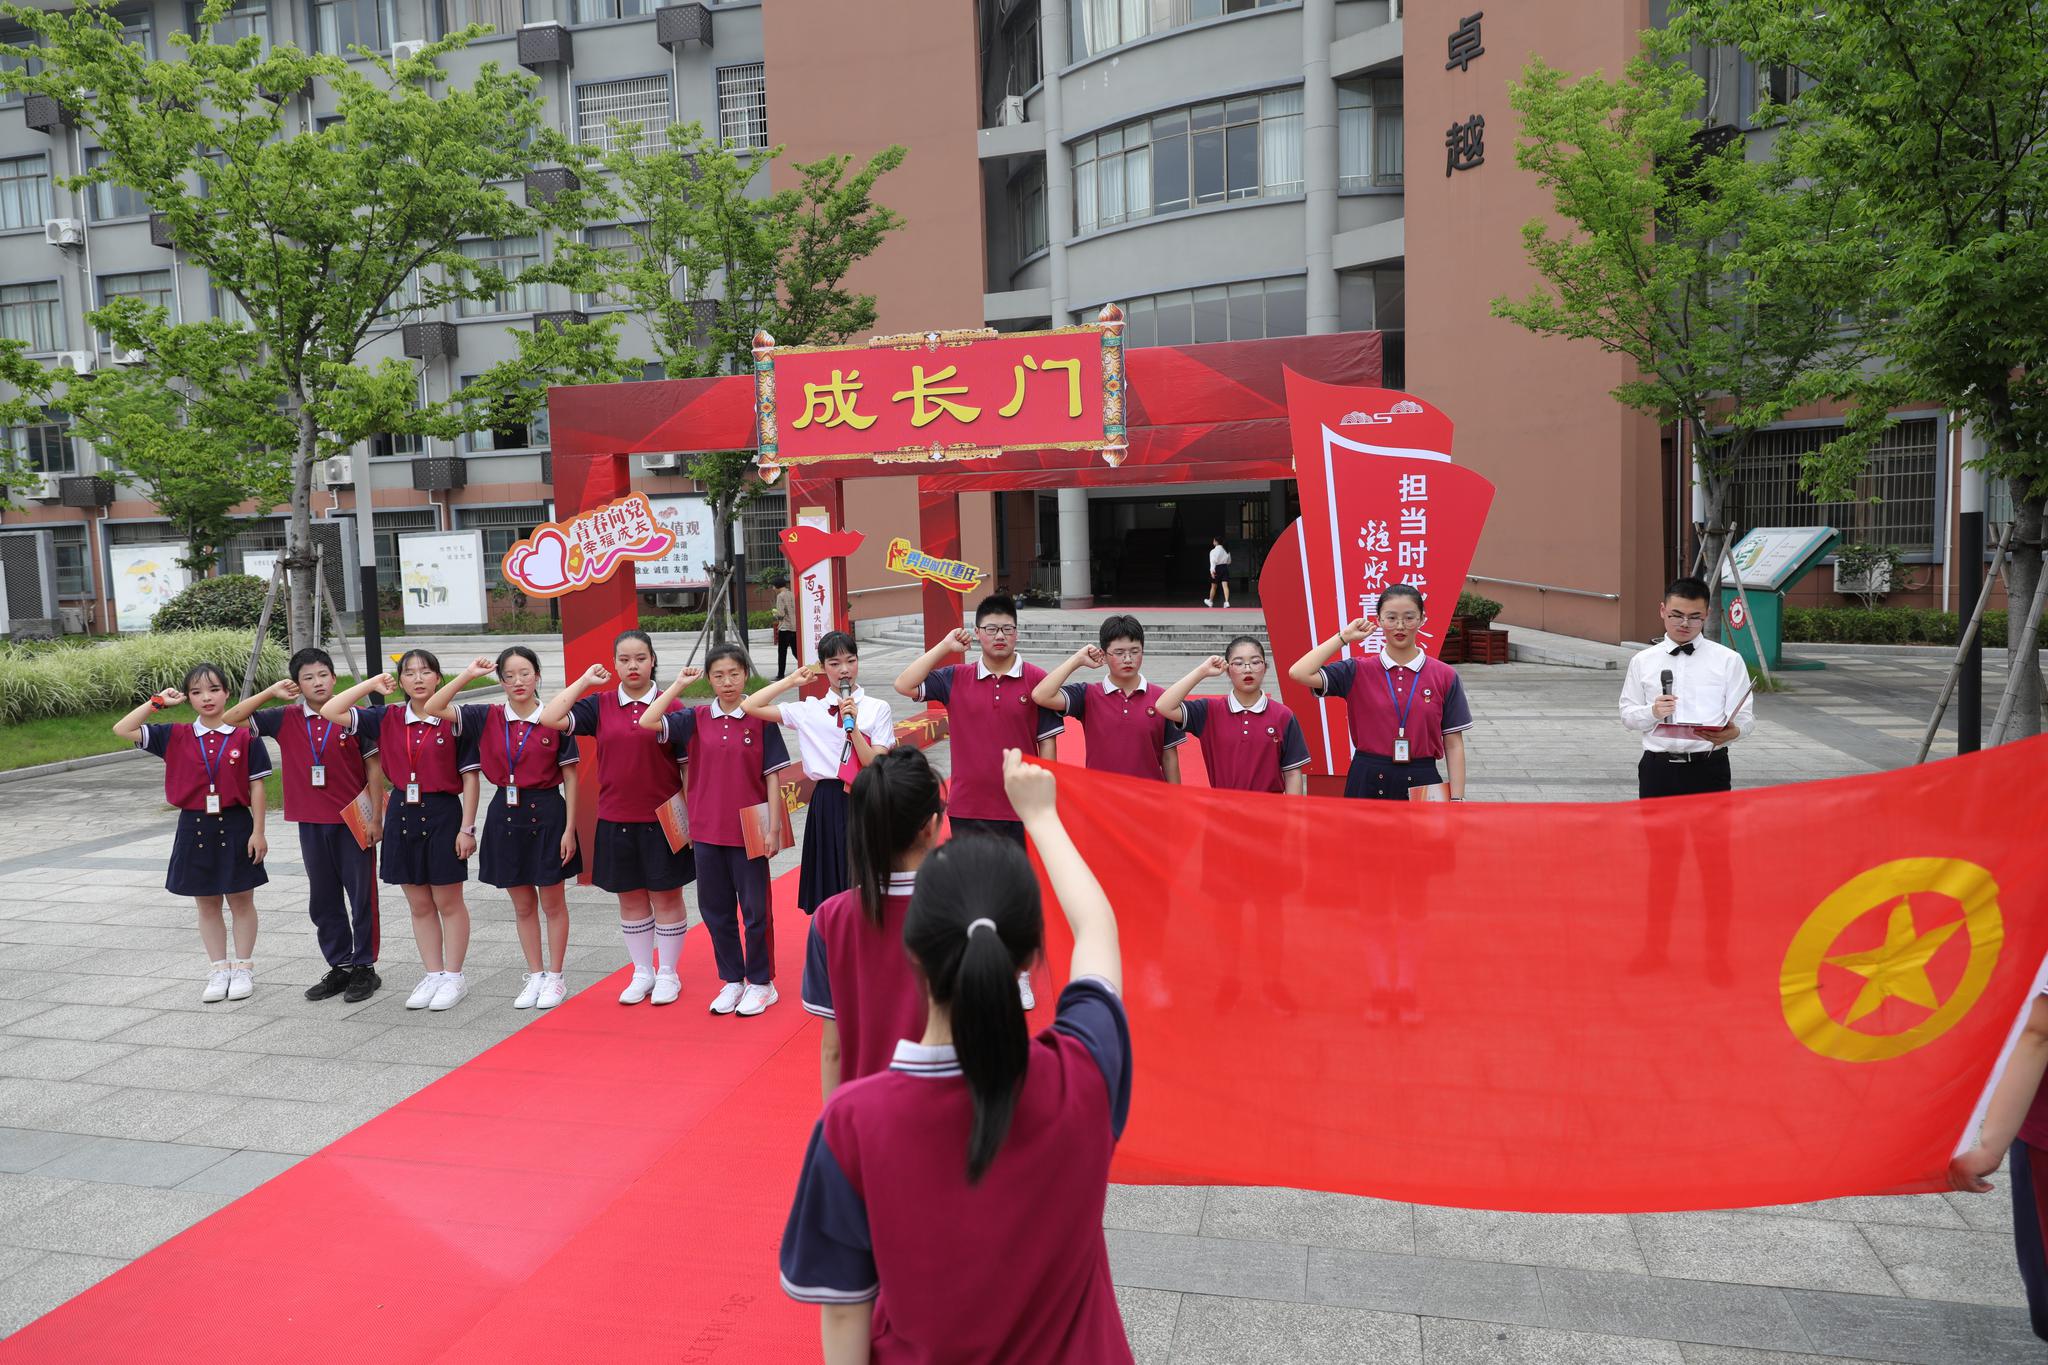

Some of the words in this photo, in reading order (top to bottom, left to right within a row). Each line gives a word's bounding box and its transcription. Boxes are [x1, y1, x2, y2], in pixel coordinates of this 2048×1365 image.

[1445, 11, 1485, 178] 卓越
[792, 354, 1083, 430] 成长门
[573, 500, 644, 542] 青春向党
[583, 520, 650, 555] 幸福成长
[906, 551, 977, 581] 勇担时代重任
[1398, 473, 1434, 649] 担当时代
[803, 573, 826, 607] 百年
